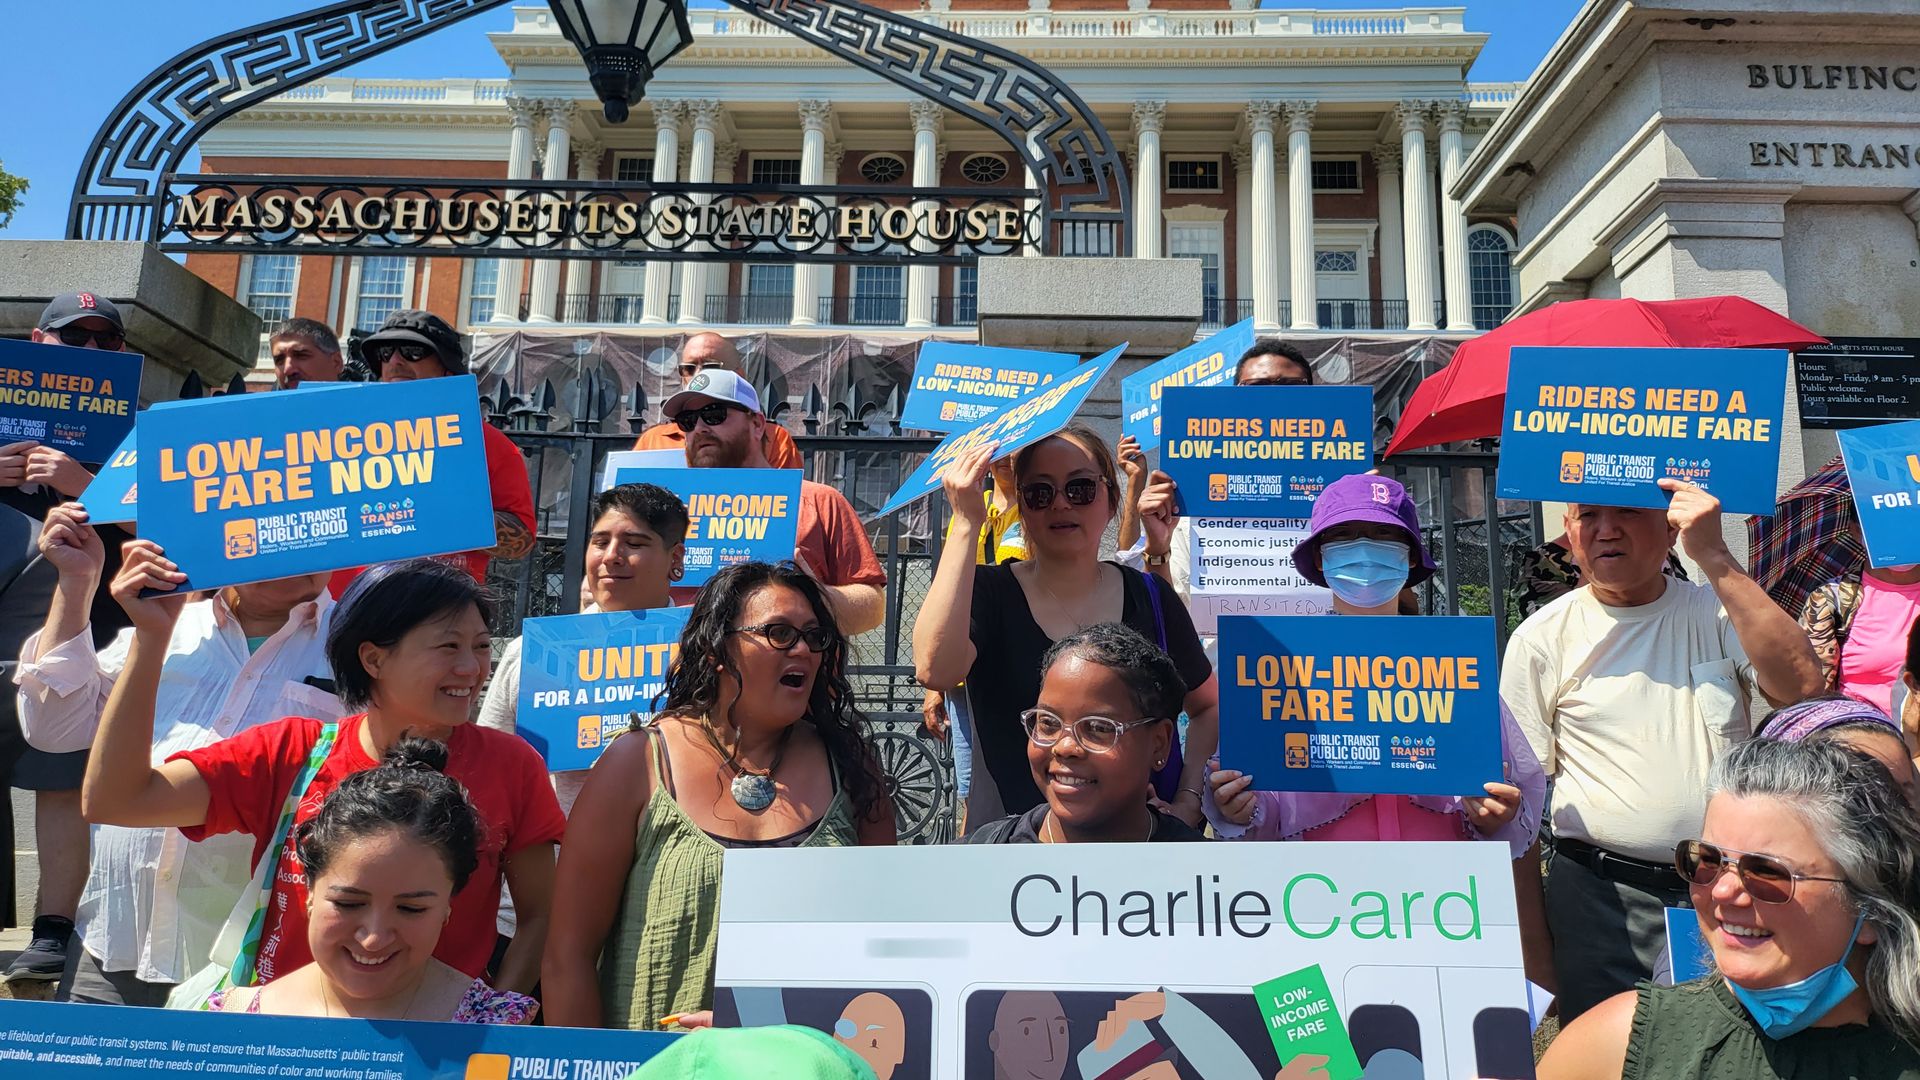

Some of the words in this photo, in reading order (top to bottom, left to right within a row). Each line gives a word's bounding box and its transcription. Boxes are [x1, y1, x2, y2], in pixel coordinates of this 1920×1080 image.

[1747, 64, 1920, 91] BULFINC
[1750, 142, 1920, 168] ENTRAN
[176, 195, 638, 237] MASSACHUSETTS
[657, 202, 817, 241] STATE
[834, 205, 1023, 243] HOUSE
[934, 363, 992, 381] RIDERS
[996, 369, 1038, 386] NEED
[1150, 352, 1224, 400] UNITED
[1799, 363, 1827, 372] Hours:
[41, 372, 94, 394] NEED
[100, 380, 112, 396] A
[916, 376, 1020, 399] LOW-INCOME
[1800, 373, 1834, 384] Monday
[1873, 374, 1879, 382] 9
[1902, 374, 1907, 383] 5
[1800, 384, 1826, 392] Public
[1829, 384, 1866, 393] welcome.
[78, 396, 128, 416] FARE
[1538, 386, 1636, 410] RIDERS
[1644, 388, 1718, 414] NEED
[1726, 390, 1746, 414] A
[1801, 394, 1825, 403] Tours
[1827, 394, 1861, 403] available
[1877, 395, 1898, 404] Floor
[19, 418, 47, 428] TRANSIT
[1130, 407, 1149, 424] FOR
[1150, 403, 1158, 414] A
[24, 428, 46, 437] GOOD
[1187, 418, 1263, 437] RIDERS
[1270, 418, 1326, 438] NEED
[1332, 419, 1346, 438] A
[1513, 410, 1688, 438] LOW-INCOME
[1697, 417, 1770, 442] FARE
[160, 414, 462, 482] LOW-INCOME
[1168, 440, 1304, 459] LOW-INCOME
[1311, 442, 1365, 460] FARE
[1586, 453, 1616, 464] PUBLIC
[1618, 455, 1656, 467] TRANSIT
[194, 466, 314, 513] FARE
[330, 450, 435, 495] NOW
[1228, 475, 1252, 484] PUBLIC
[1253, 475, 1282, 484] TRANSIT
[1585, 464, 1622, 478] PUBLIC
[1624, 465, 1654, 479] GOOD
[1665, 467, 1710, 477] TRANSIT
[1228, 484, 1258, 494] PUBLIC
[1259, 484, 1282, 494] GOOD
[1371, 483, 1390, 504] B
[1872, 492, 1912, 510] FOR
[258, 512, 298, 530] PUBLIC
[300, 506, 347, 524] TRANSIT
[360, 508, 415, 524] TRANSIT
[1198, 518, 1247, 529] Gender
[1252, 518, 1308, 530] equality
[259, 523, 307, 544] PUBLIC
[311, 518, 349, 537] GOOD
[362, 524, 416, 538] ESSENTIAL
[708, 518, 769, 540] NOW
[1198, 538, 1265, 548] Economic
[692, 555, 712, 564] GOOD
[1199, 556, 1274, 568] Indigenous
[1199, 576, 1290, 586] Environmental
[1202, 596, 1288, 615] TRANSIT
[1236, 655, 1480, 690] LOW-INCOME
[533, 690, 570, 708] FOR
[575, 688, 588, 705] A
[1261, 690, 1354, 722] FARE
[1368, 690, 1455, 724] NOW
[602, 713, 631, 725] PUBLIC
[1310, 734, 1340, 746] PUBLIC
[1342, 735, 1380, 746] TRANSIT
[1310, 746, 1349, 759] PUBLIC
[1351, 746, 1380, 760] GOOD
[1391, 747, 1436, 756] TRANSIT
[1392, 761, 1437, 770] ESSENTIAL
[1274, 986, 1312, 1008] LOW-
[1270, 999, 1330, 1029] INCOME
[1286, 1018, 1327, 1042] FARE
[8, 1030, 44, 1042] lifeblood
[45, 1032, 56, 1044] of
[56, 1036, 71, 1044] our
[71, 1035, 98, 1047] public
[100, 1037, 129, 1048] transit
[129, 1040, 168, 1052] systems.
[172, 1040, 186, 1052] We
[187, 1043, 210, 1053] must
[212, 1045, 243, 1054] ensure
[246, 1044, 266, 1056] that
[341, 1049, 371, 1062] public
[372, 1051, 404, 1063] transit
[37, 1051, 54, 1062] and
[55, 1053, 103, 1066] accessible,
[105, 1056, 122, 1067] and
[124, 1058, 147, 1068] meet
[149, 1058, 164, 1069] the
[166, 1060, 192, 1071] needs
[194, 1061, 206, 1072] of
[206, 1062, 266, 1075] communities
[268, 1063, 280, 1075] of
[280, 1066, 304, 1076] color
[305, 1066, 323, 1077] and
[325, 1068, 363, 1080] working
[512, 1056, 569, 1080] PUBLIC
